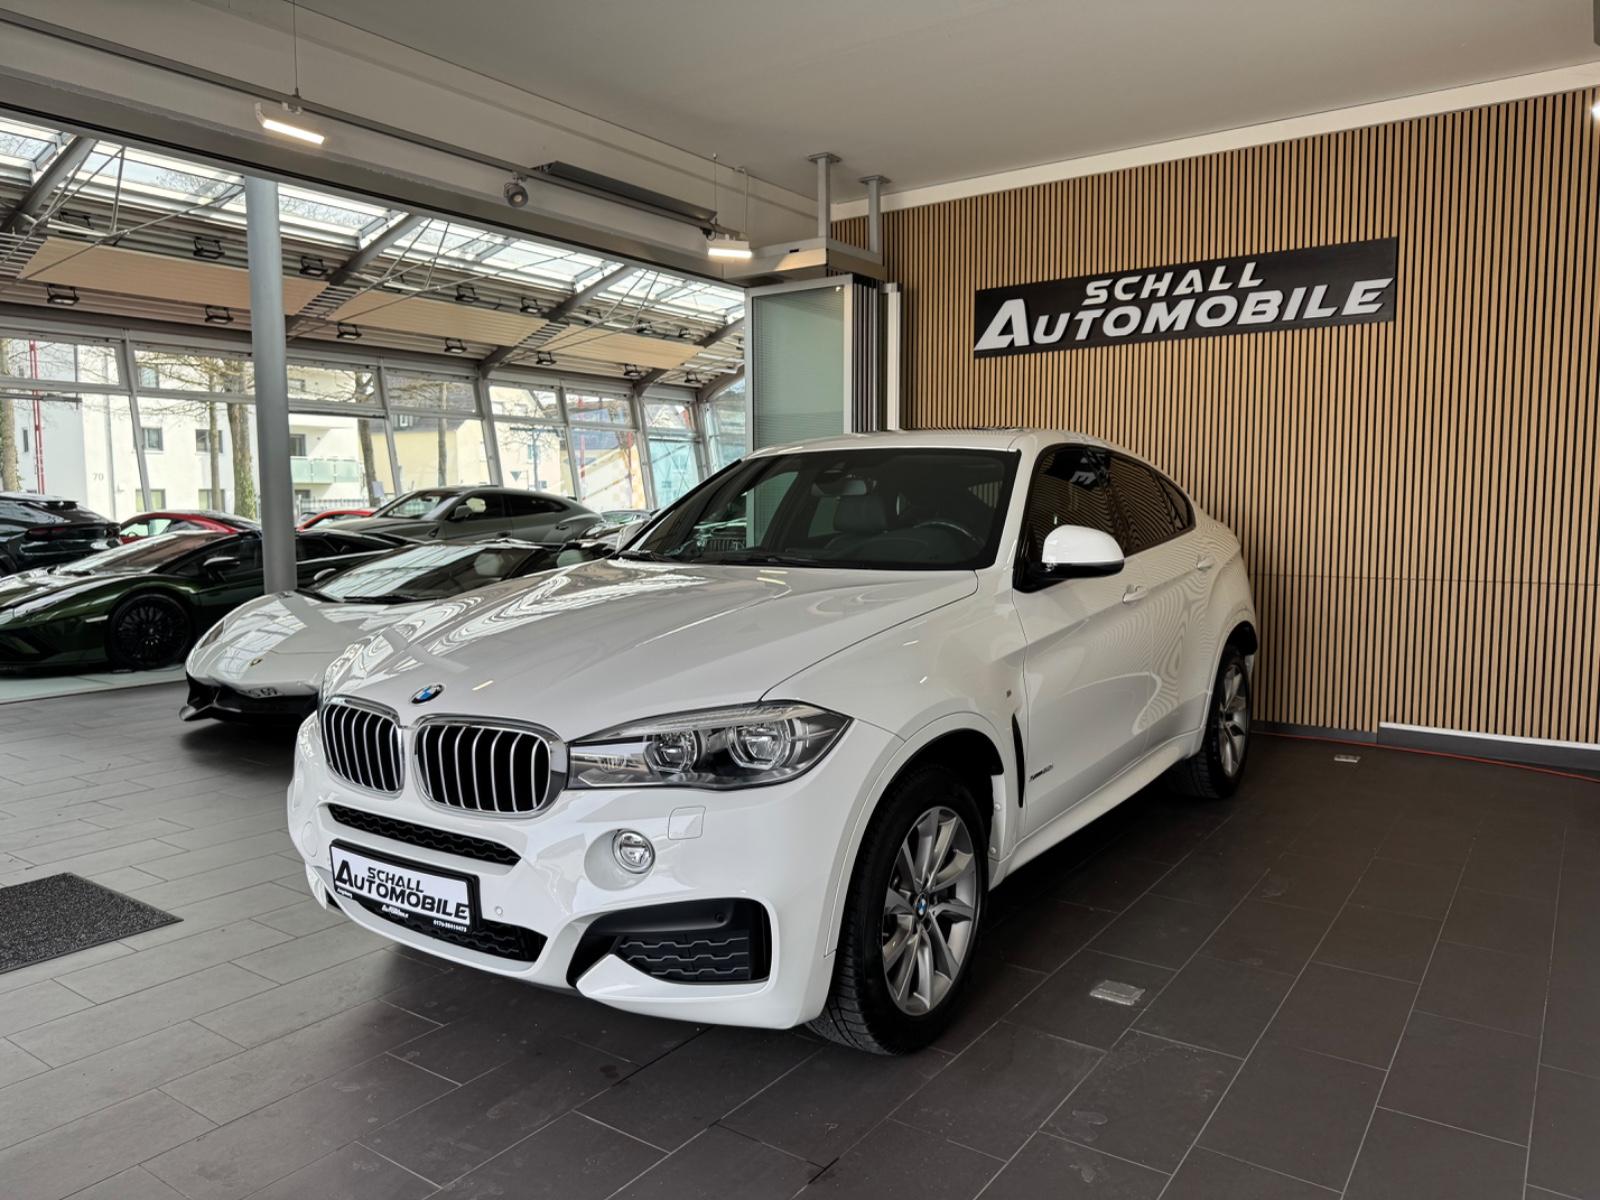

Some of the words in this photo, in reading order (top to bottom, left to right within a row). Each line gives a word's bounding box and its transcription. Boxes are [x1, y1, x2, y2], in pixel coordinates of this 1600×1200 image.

[1082, 261, 1265, 306] SCHALL
[974, 277, 1394, 351] AUTOMOBILE
[93, 472, 104, 481] 70
[335, 860, 469, 920] AUTOMOBILE
[367, 867, 424, 894] SCHALL
